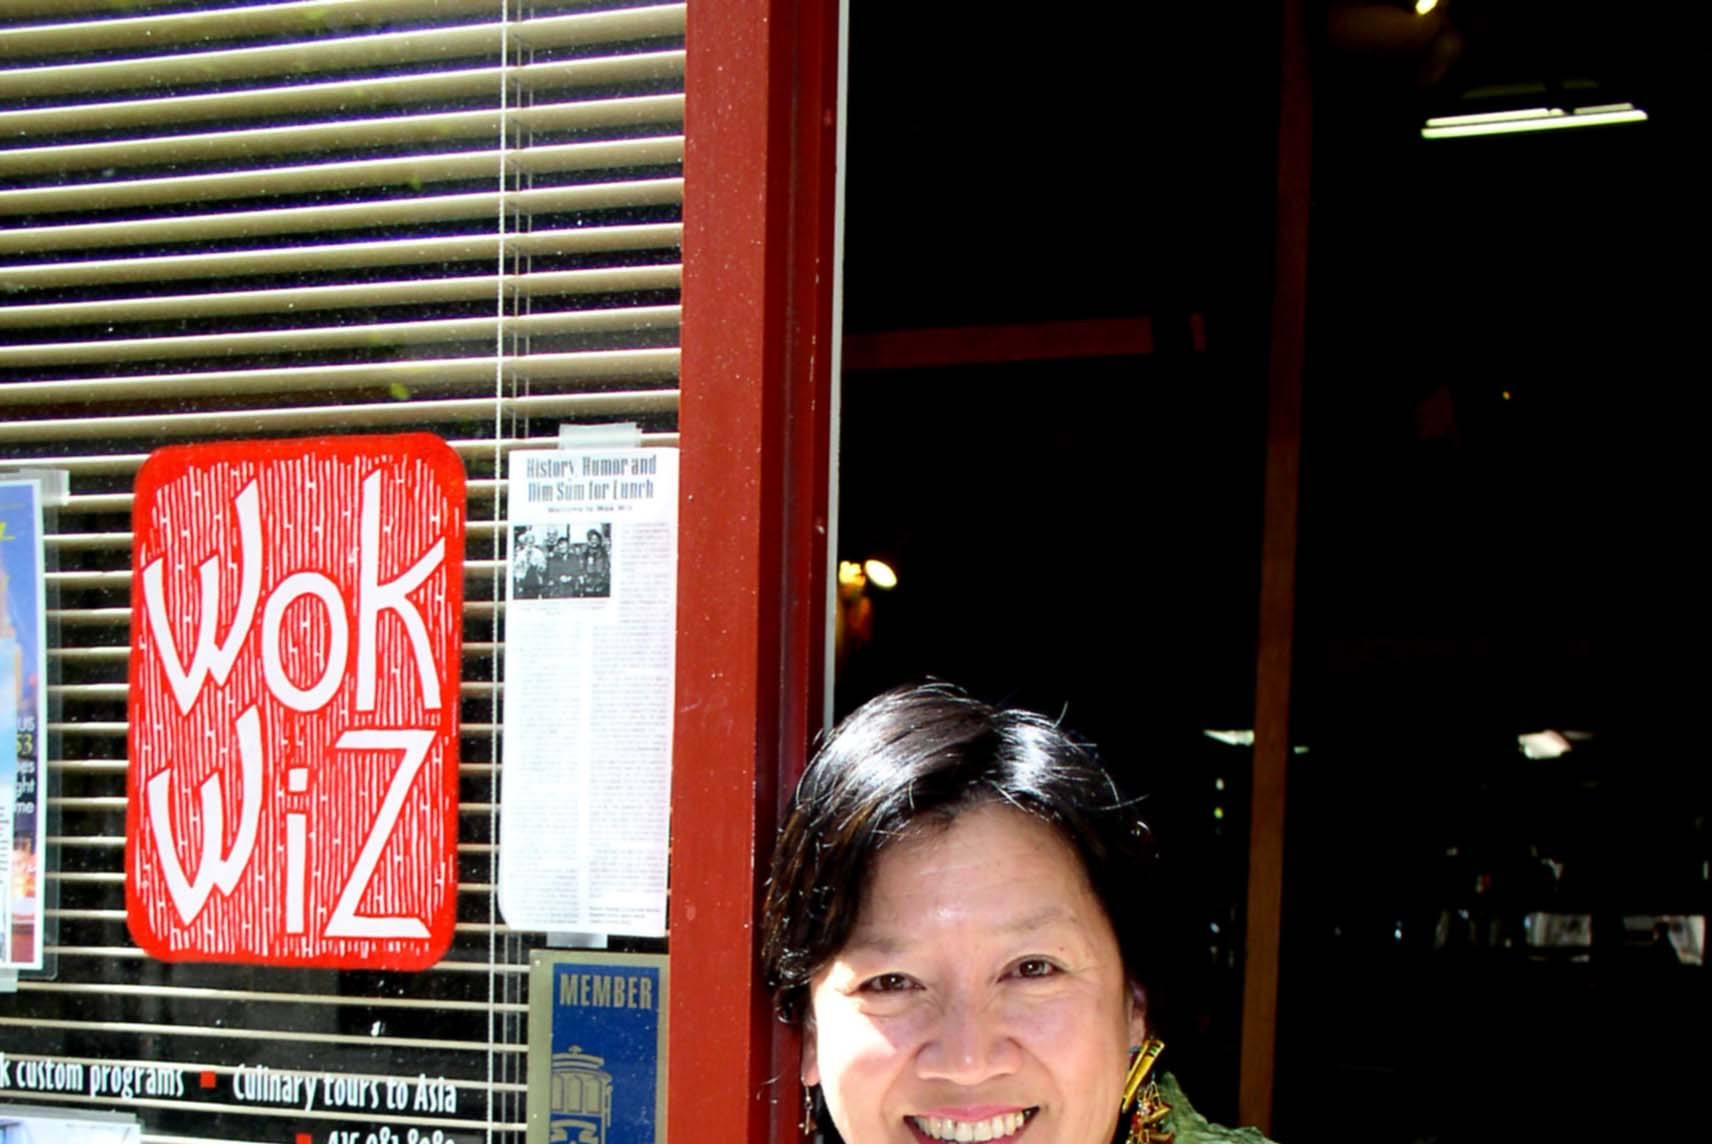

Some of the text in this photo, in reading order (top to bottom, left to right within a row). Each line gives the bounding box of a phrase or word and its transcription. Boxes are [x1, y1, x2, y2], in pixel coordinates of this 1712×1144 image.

[582, 454, 629, 476] Humor
[631, 454, 657, 475] and
[528, 479, 654, 502] Dim Sum for Lunch
[560, 973, 652, 1009] MEMBER
[16, 1060, 84, 1092] custom
[90, 1064, 185, 1099] programs
[233, 1063, 317, 1112] Culinary
[323, 1073, 379, 1110] tours
[386, 1075, 409, 1110] to
[413, 1073, 458, 1114] Asia
